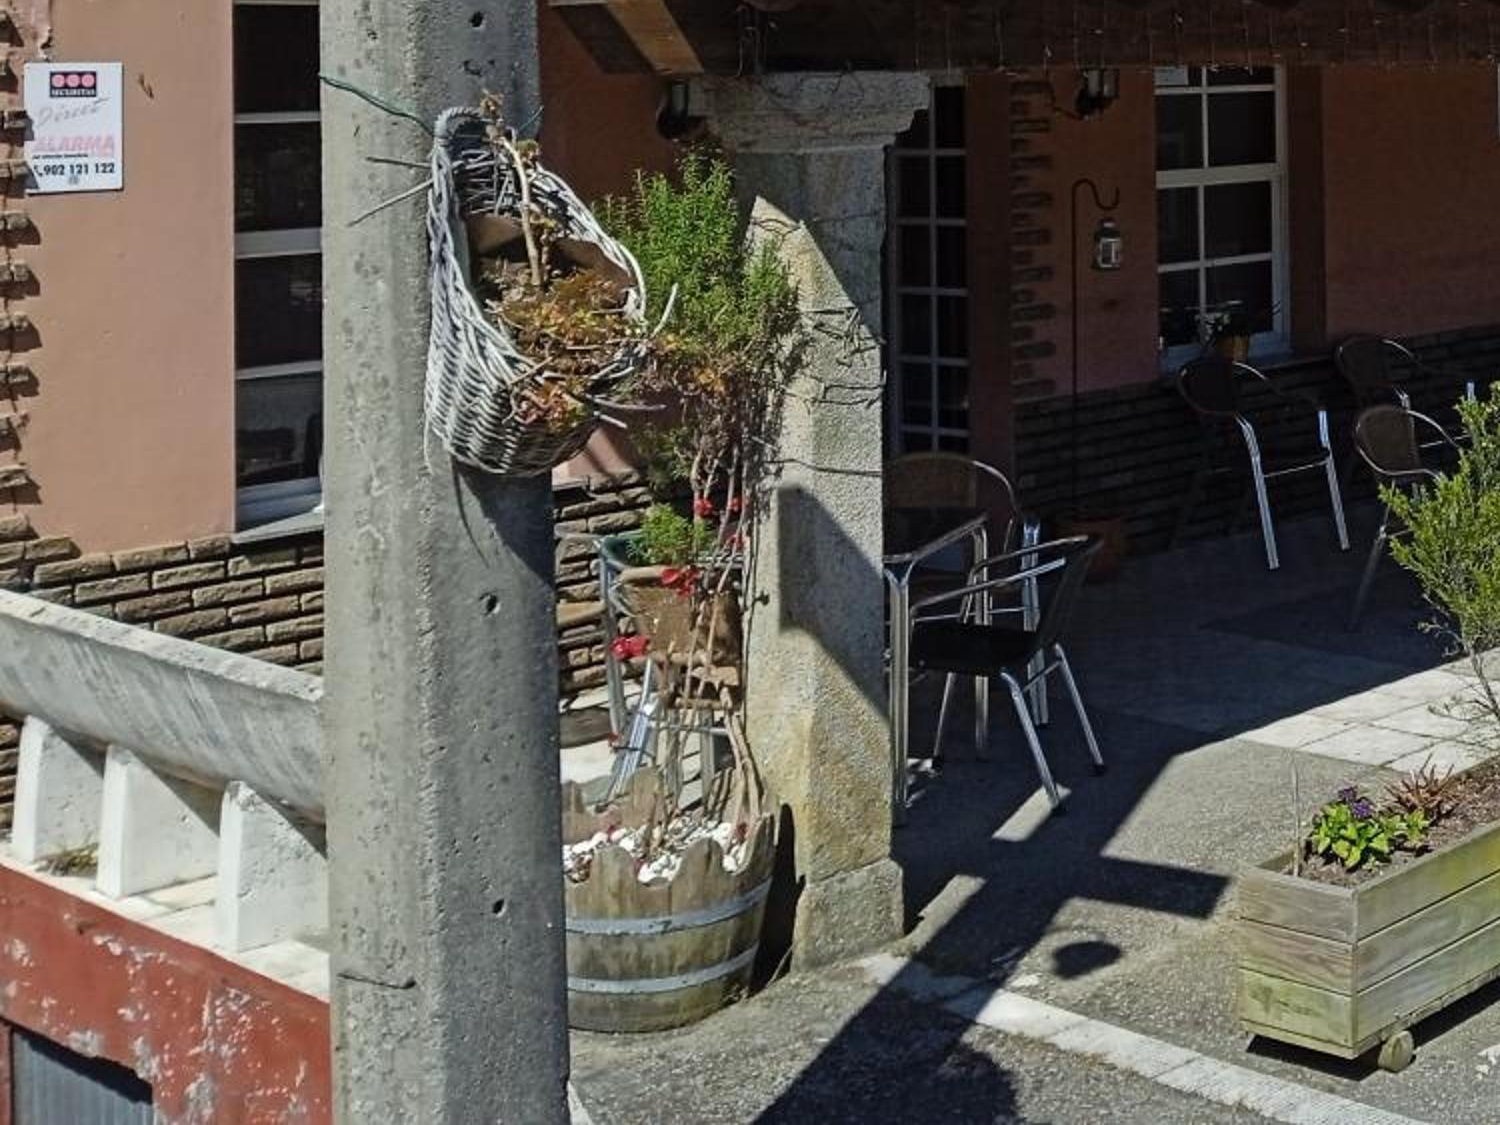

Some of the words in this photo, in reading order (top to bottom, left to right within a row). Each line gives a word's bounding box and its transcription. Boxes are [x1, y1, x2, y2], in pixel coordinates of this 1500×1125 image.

[33, 134, 115, 153] ALARMA
[43, 164, 65, 175] 902
[69, 163, 89, 175] 121
[95, 162, 115, 173] 122
